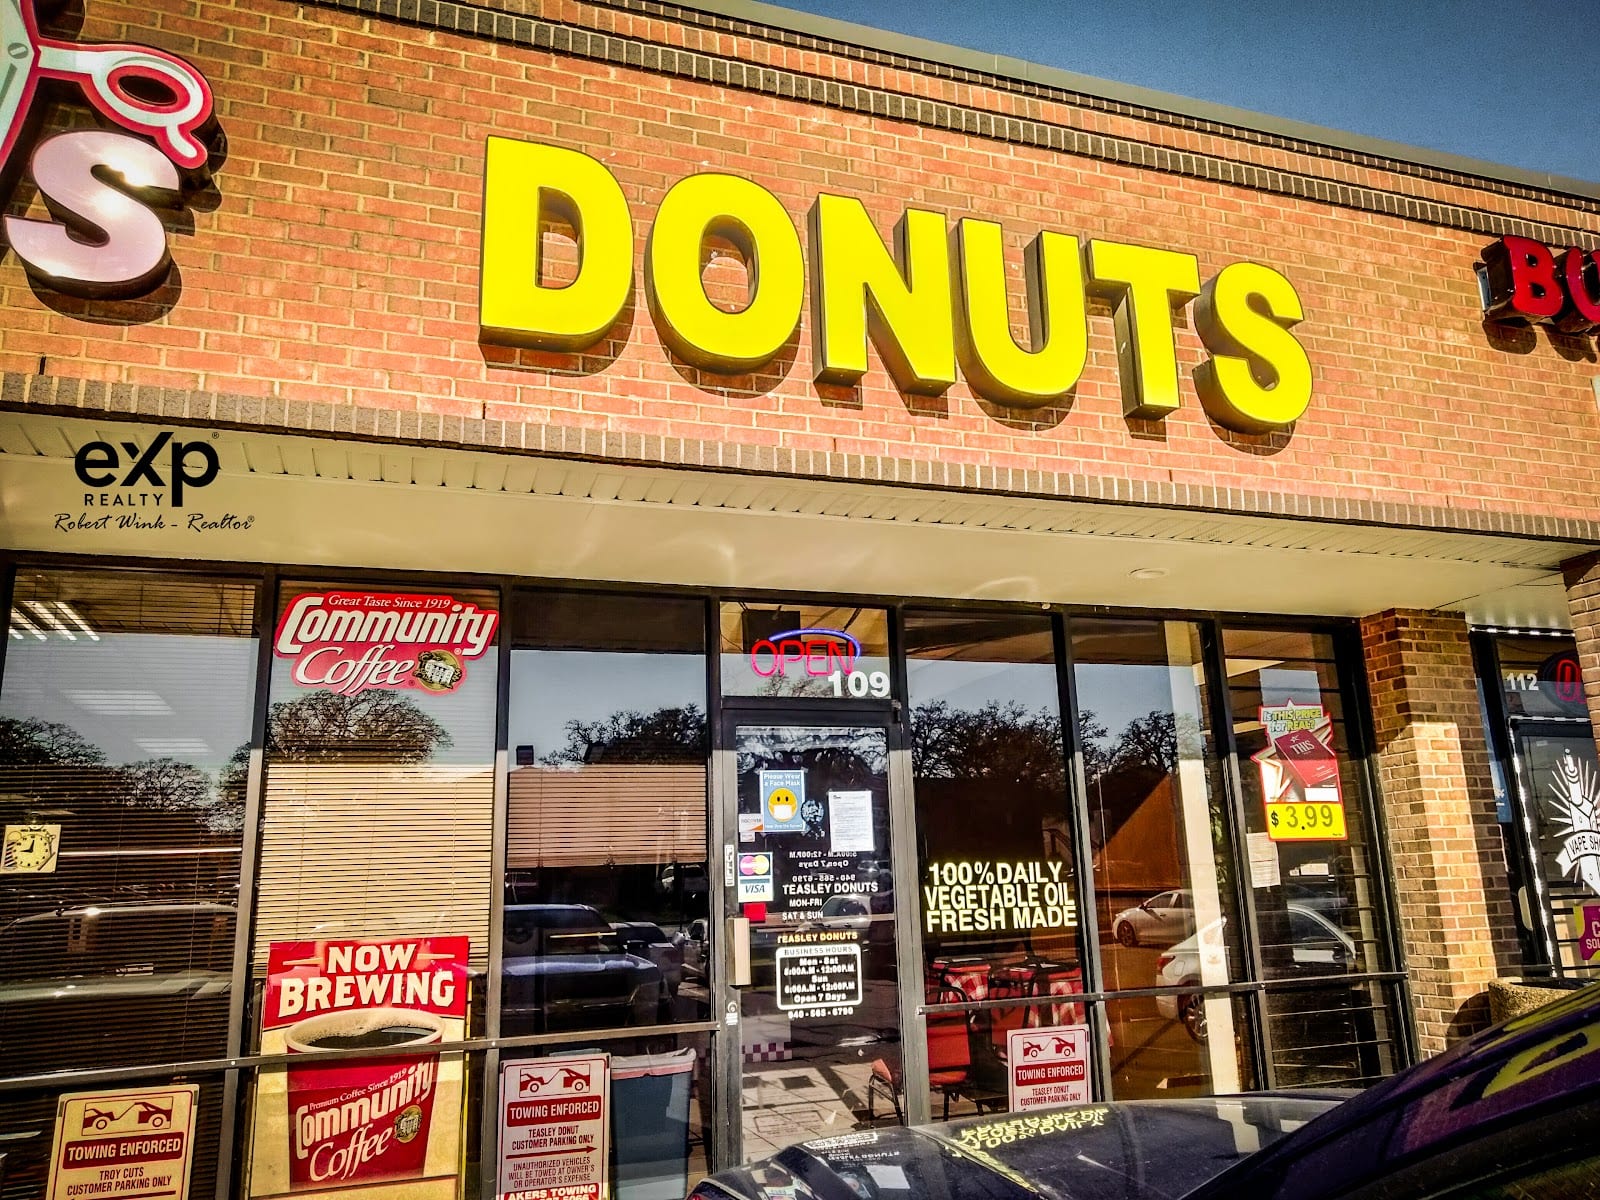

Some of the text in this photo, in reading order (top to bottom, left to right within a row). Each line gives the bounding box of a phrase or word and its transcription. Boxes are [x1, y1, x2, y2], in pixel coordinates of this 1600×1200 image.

[479, 135, 1313, 428] DONUTS
[328, 594, 450, 609] Great Taste Since 1919
[277, 596, 497, 656] Community
[751, 639, 855, 678] OPEN
[295, 644, 415, 694] Coffee
[827, 670, 890, 698] 109
[1506, 672, 1540, 691] 112
[1273, 709, 1295, 721] THIS
[1295, 708, 1322, 720] PRICE
[1269, 720, 1316, 733] for REAL?
[1290, 740, 1315, 755] THIS
[1568, 835, 1600, 855] VAPE SH
[744, 884, 766, 894] VISA
[782, 882, 878, 895] TEASLEY DONUTS
[924, 882, 1075, 910] VEGETABLE OIL
[789, 898, 823, 907] MON-FRI
[782, 912, 798, 921] SAT
[806, 911, 824, 920] SUN
[926, 905, 1078, 933] FRESH MADE
[777, 931, 858, 943] TEASLEY DONUTS
[327, 943, 417, 974] NOW
[784, 947, 824, 956] BUSINESS
[799, 958, 818, 966] Mon
[811, 975, 828, 983] Sun
[278, 970, 456, 1018] BREWING
[794, 993, 847, 1004] Open 7 Days
[1017, 1064, 1084, 1081] TOWING ENFORCED
[309, 1067, 407, 1111] Premium Coffee Since 1919
[1032, 1085, 1070, 1096] TEASLEY DONUT
[1020, 1093, 1081, 1106] CUSTOMER PARKING ONLY
[295, 1056, 435, 1160] Community
[510, 1101, 600, 1120] TOWING ENFORCED
[528, 1125, 579, 1138] TEASLEY DONUT
[67, 1138, 181, 1161] TOWING ENFORCED
[511, 1134, 595, 1150] CUSTOMER PARKING ONLY
[309, 1123, 393, 1182] Coffee
[513, 1156, 591, 1172] UNAUTHORIZED VEHICLES
[99, 1167, 144, 1180] TROY CUTS
[508, 1165, 595, 1180] WILL BE TOWED AT OWNER'S
[67, 1176, 172, 1196] CUSTOMER PARKING ONLY
[513, 1173, 591, 1189] OR OPERATOR'S EXPENSE
[507, 1184, 597, 1200] AKERS TOWING
